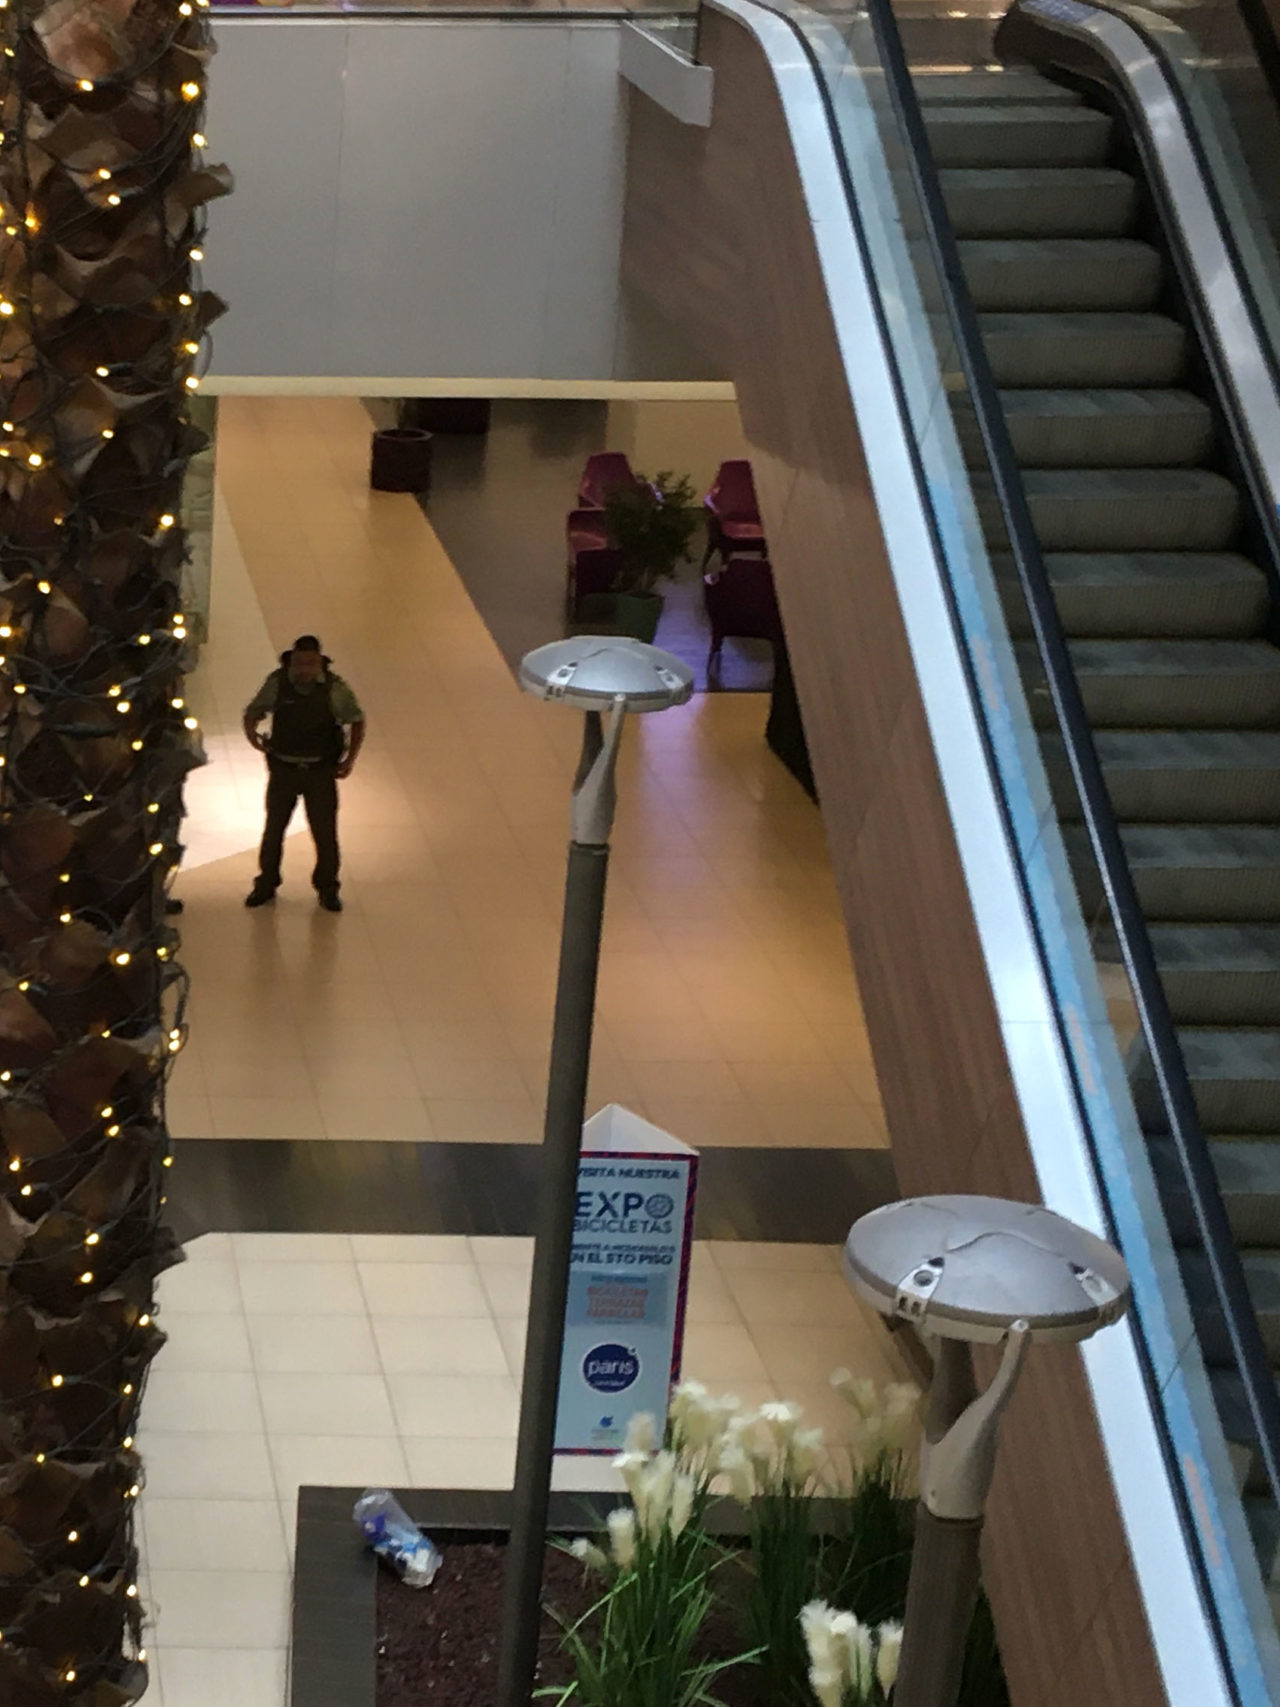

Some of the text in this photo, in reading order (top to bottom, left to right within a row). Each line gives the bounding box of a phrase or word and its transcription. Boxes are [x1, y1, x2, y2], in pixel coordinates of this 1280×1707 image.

[618, 1168, 680, 1180] NUESTRA
[576, 1191, 674, 1219] EXPO
[573, 1219, 673, 1234] BICICLETAS
[586, 1253, 602, 1265] EL
[638, 1254, 673, 1266] PISO
[587, 1360, 634, 1378] paris
